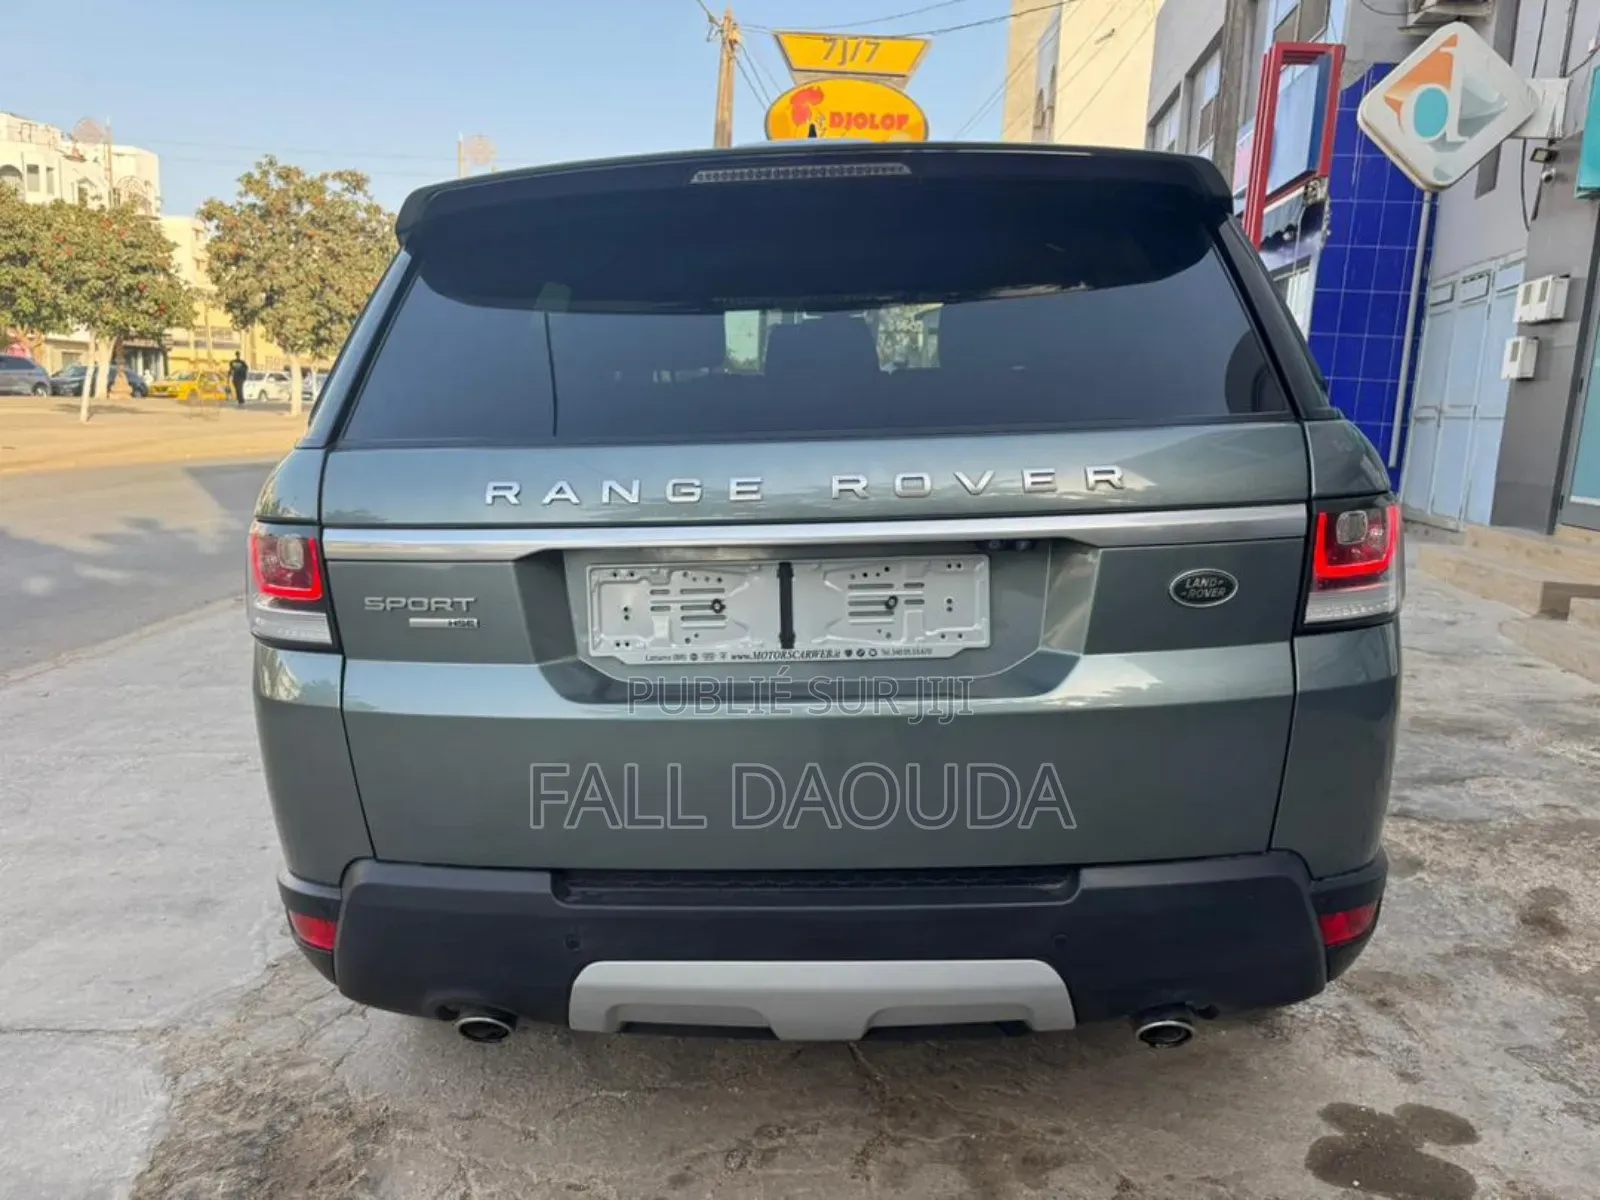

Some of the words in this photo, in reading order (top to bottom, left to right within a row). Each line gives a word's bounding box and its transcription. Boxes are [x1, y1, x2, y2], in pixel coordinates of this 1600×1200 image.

[485, 476, 763, 505] RANGE
[831, 465, 1126, 500] ROVER
[1188, 588, 1226, 598] ROVER
[363, 596, 476, 611] SPORT
